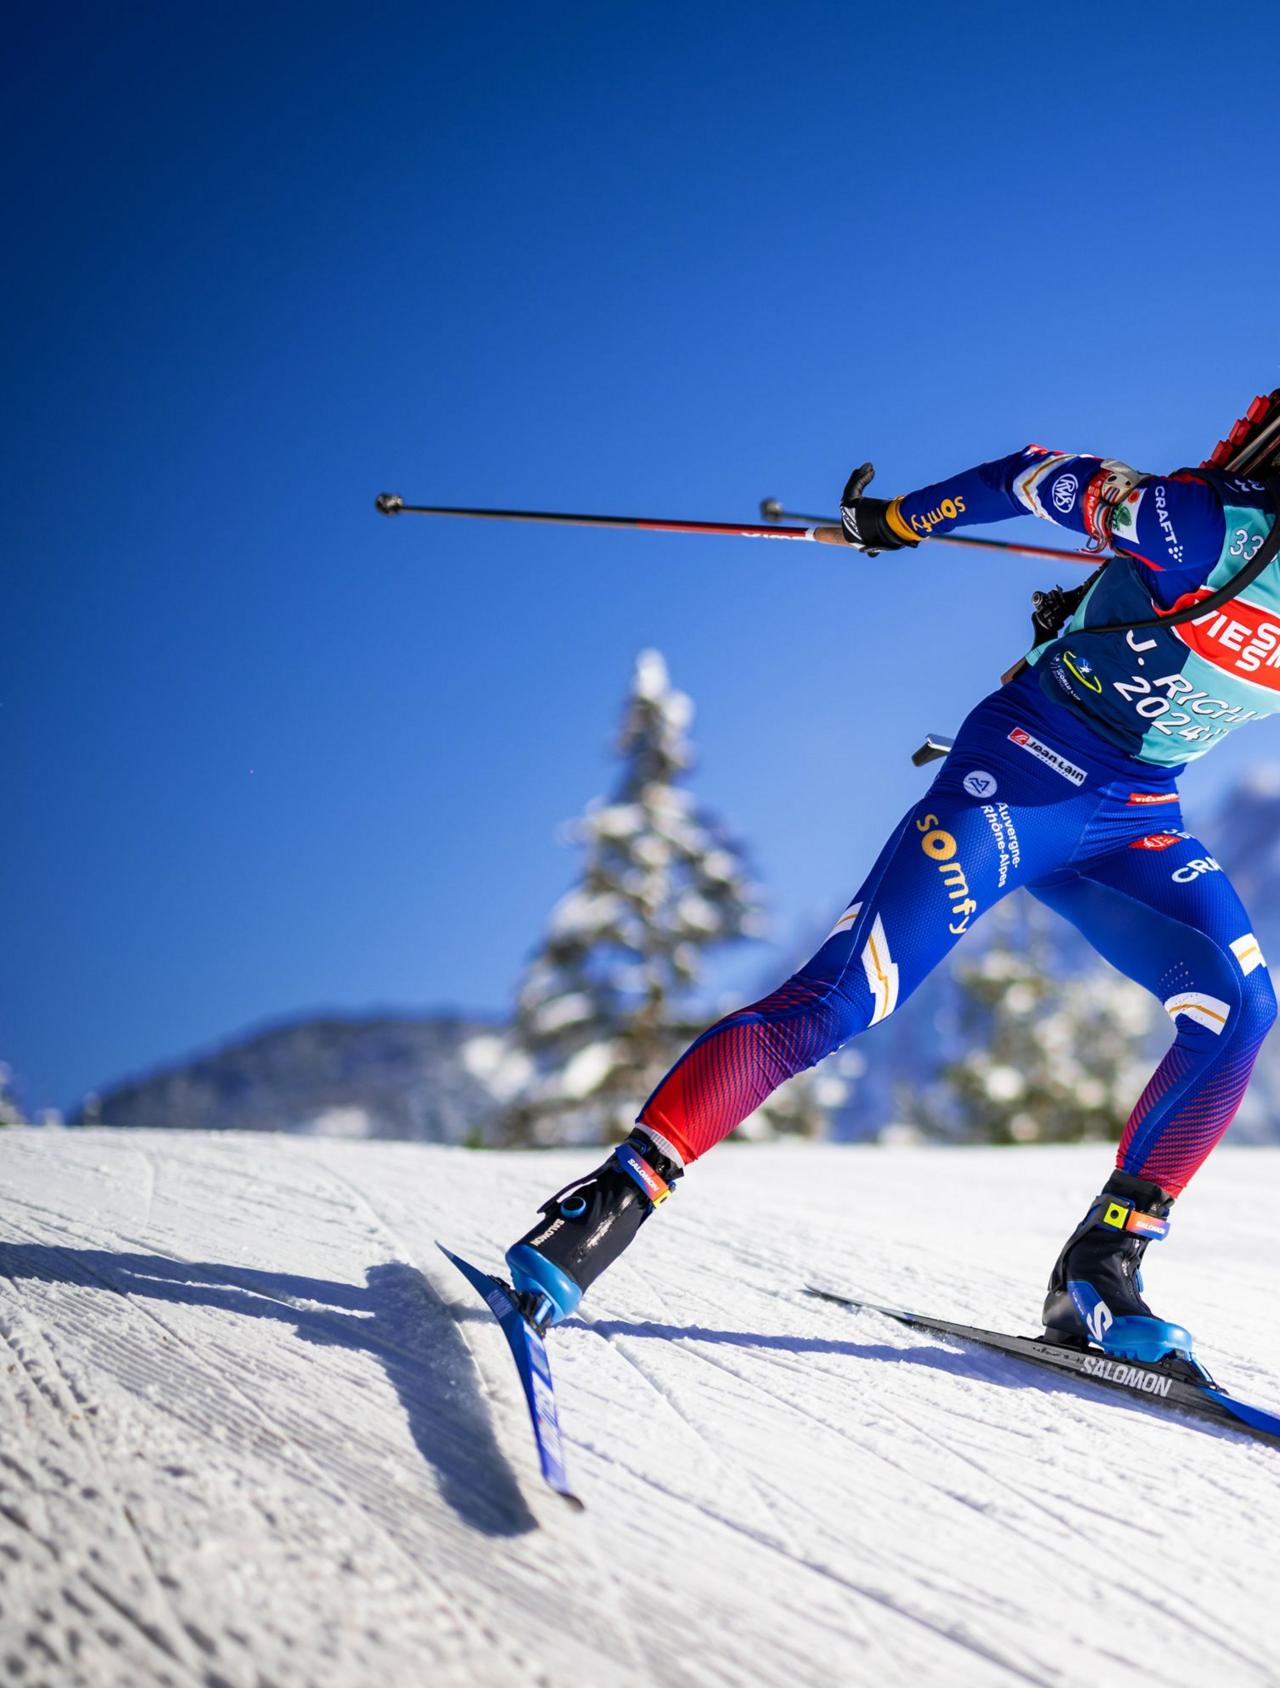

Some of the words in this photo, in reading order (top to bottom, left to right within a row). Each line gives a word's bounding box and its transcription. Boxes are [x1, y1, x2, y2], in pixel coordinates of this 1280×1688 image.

[1055, 477, 1075, 509] RWS
[910, 496, 966, 533] somfy
[1154, 485, 1178, 544] CRAFT
[1126, 629, 1157, 667] J.
[1027, 741, 1058, 764] Jean
[1058, 761, 1085, 783] Lain
[980, 804, 1010, 888] Rhône-Alpes
[995, 802, 1021, 869] Auvergne-
[916, 813, 977, 935] somfy
[627, 1158, 660, 1192] SALOMON
[1080, 1356, 1173, 1398] SALOMON
